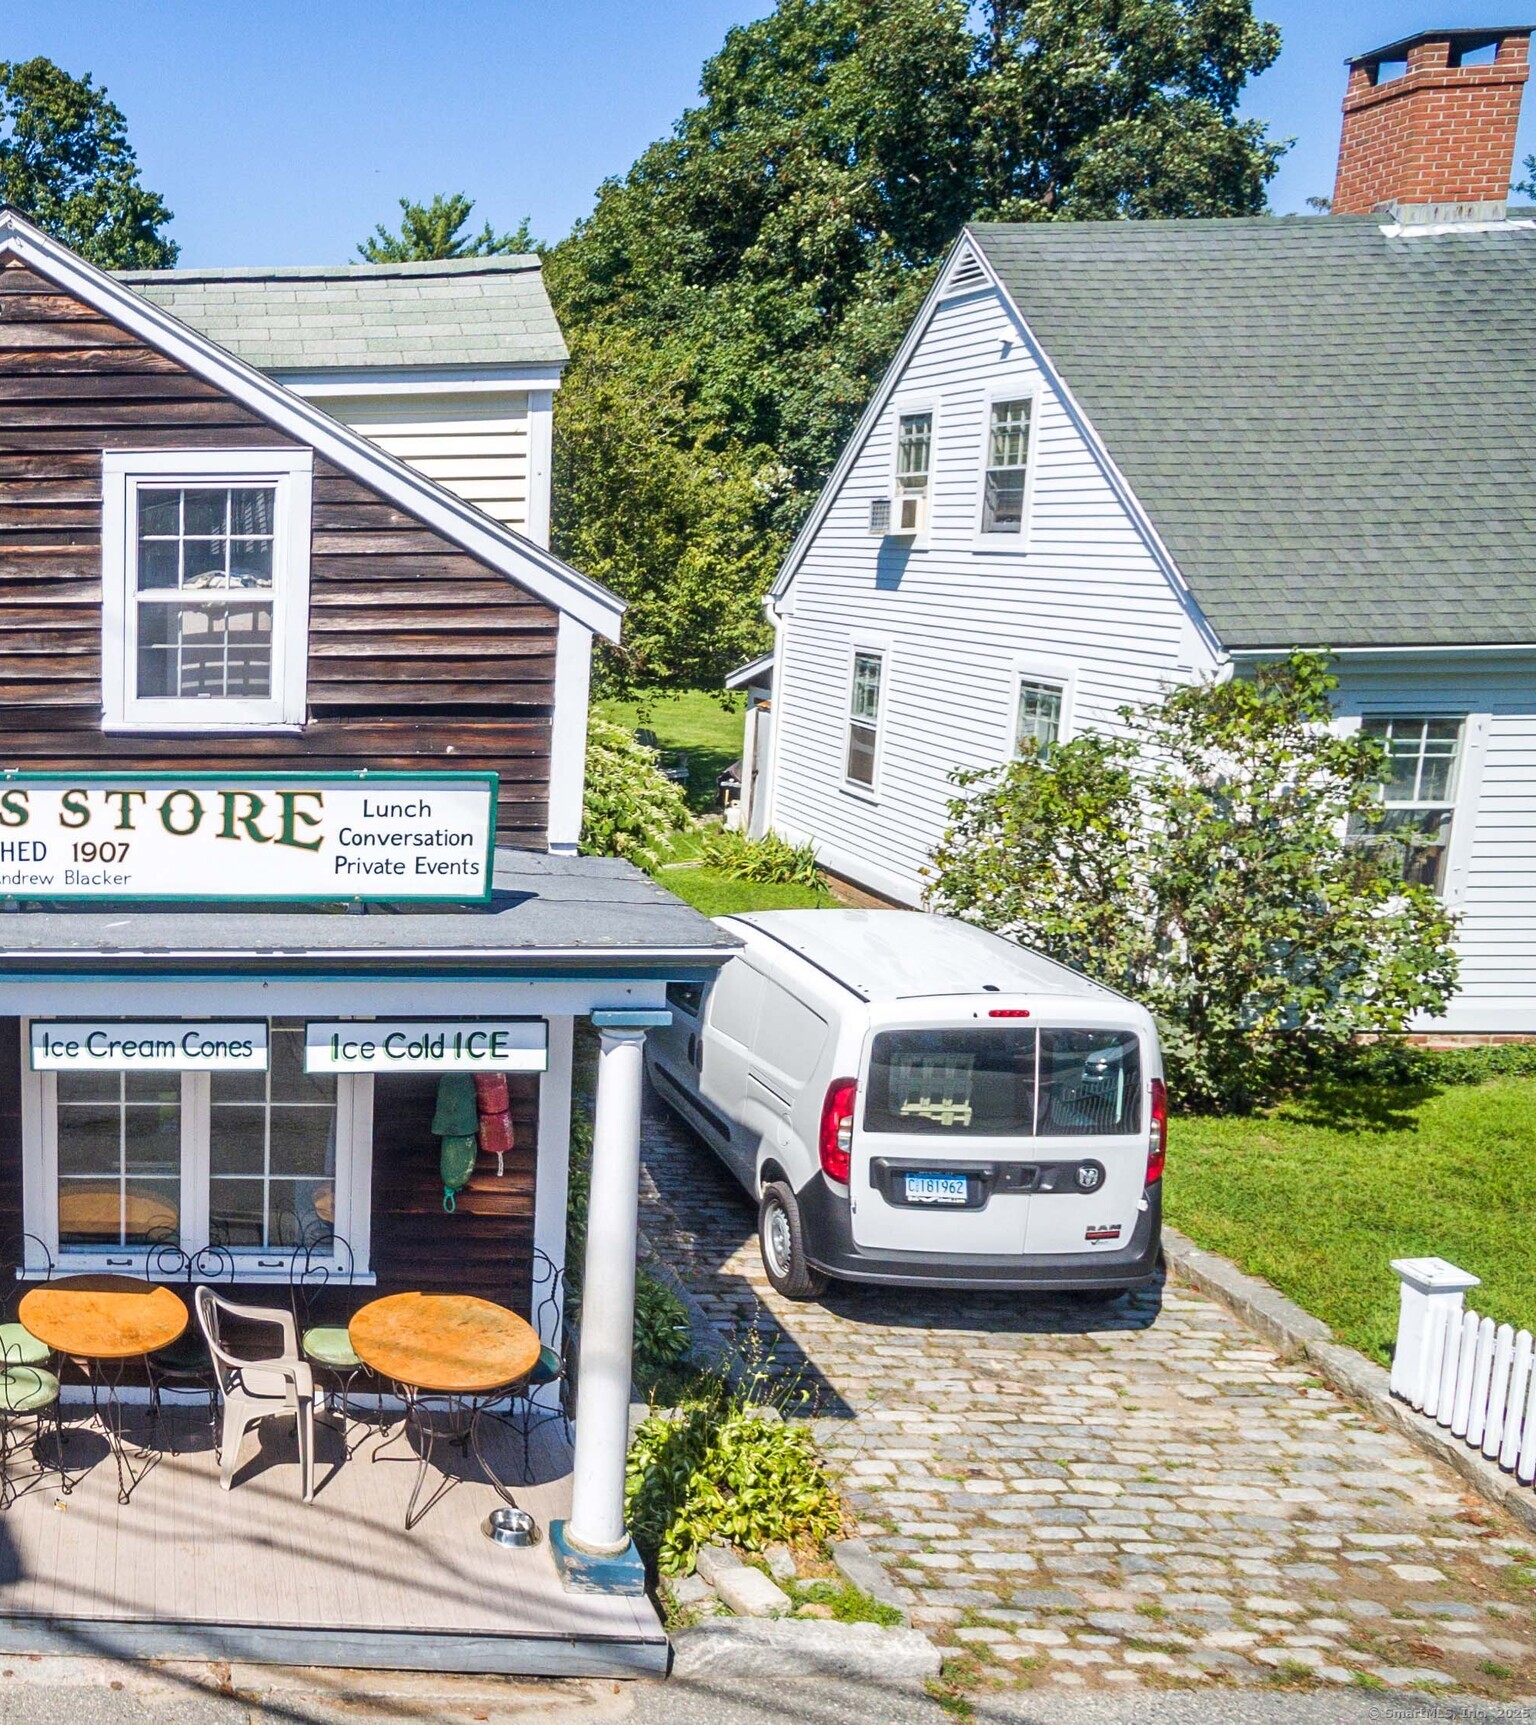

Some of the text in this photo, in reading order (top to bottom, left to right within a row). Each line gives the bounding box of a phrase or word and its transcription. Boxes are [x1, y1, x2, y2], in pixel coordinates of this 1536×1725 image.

[363, 799, 432, 818] Lunch
[58, 788, 325, 853] STORE
[338, 827, 474, 848] Conversation
[72, 841, 130, 863] 1907
[334, 856, 480, 876] Private Events
[65, 869, 132, 885] Blacker
[43, 1031, 253, 1059] Ice Cream Cones
[331, 1031, 510, 1061] Ice Cold ICE
